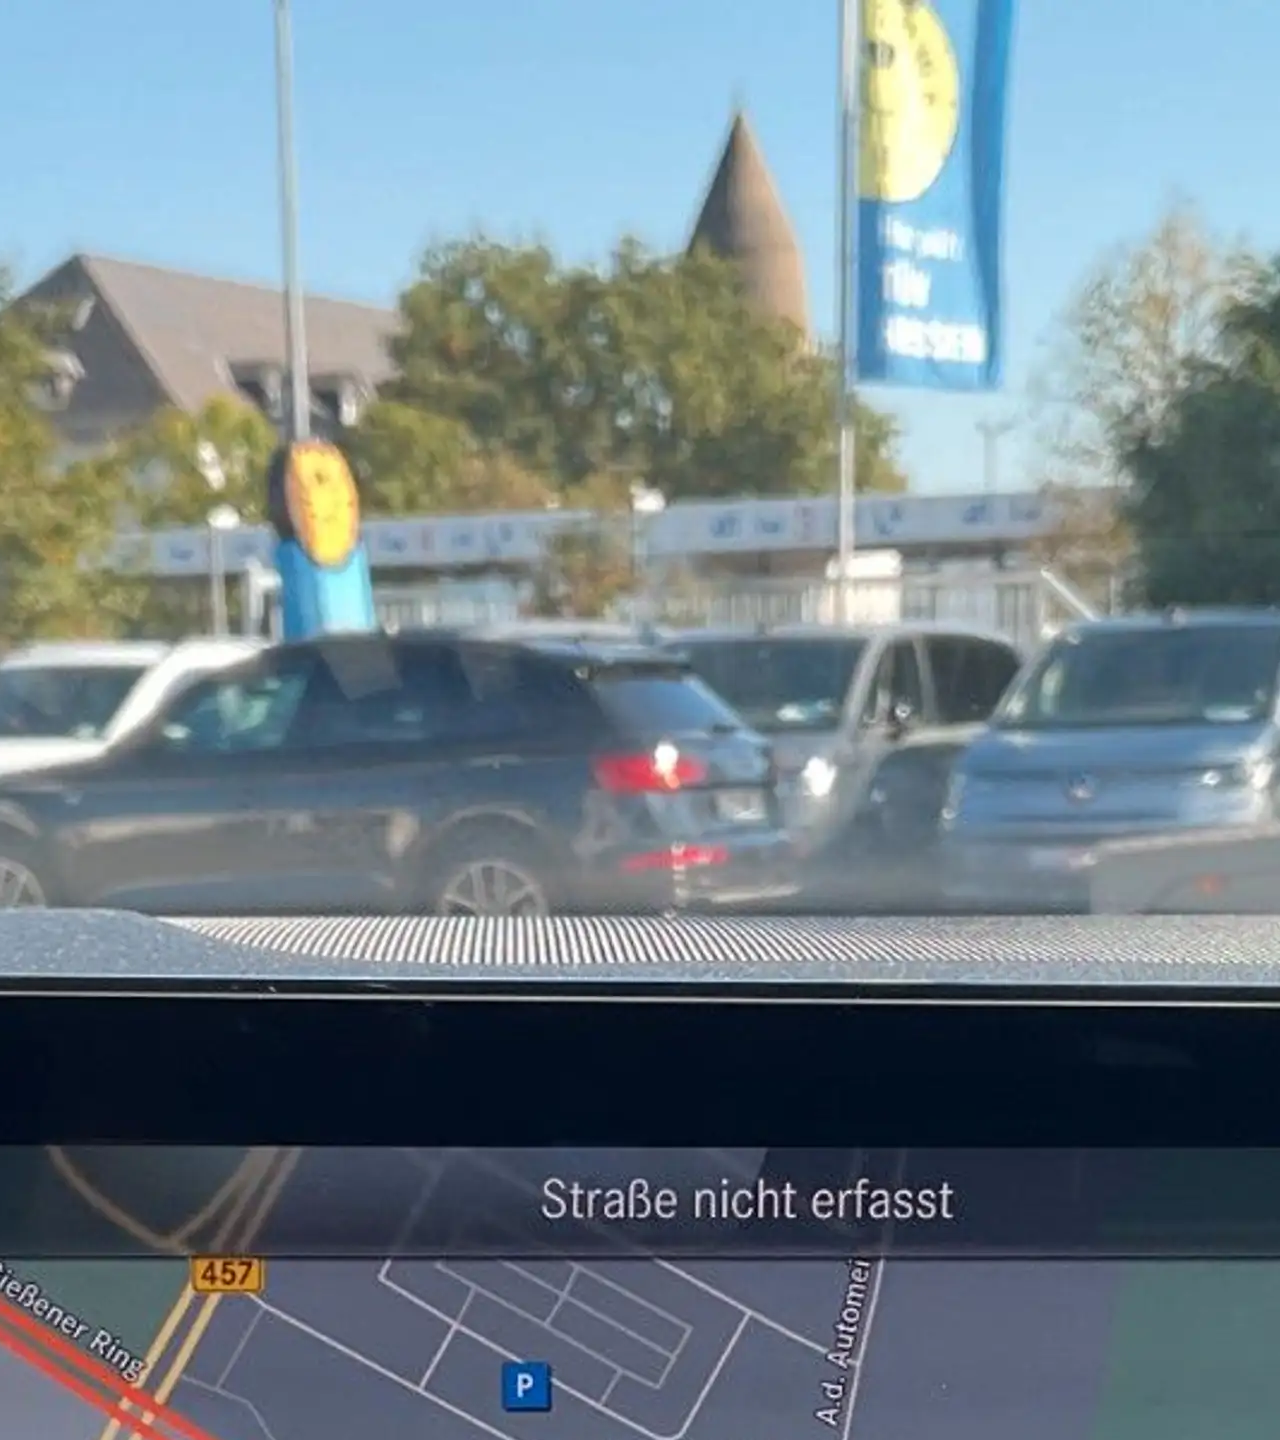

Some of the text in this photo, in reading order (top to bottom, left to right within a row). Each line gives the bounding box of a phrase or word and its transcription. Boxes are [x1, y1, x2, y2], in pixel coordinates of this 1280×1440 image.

[541, 1178, 955, 1219] Straße nicht erfasst
[200, 1260, 254, 1287] 457
[89, 1329, 148, 1381] Ring
[516, 1373, 535, 1399] P
[815, 1376, 847, 1427] A.d.
